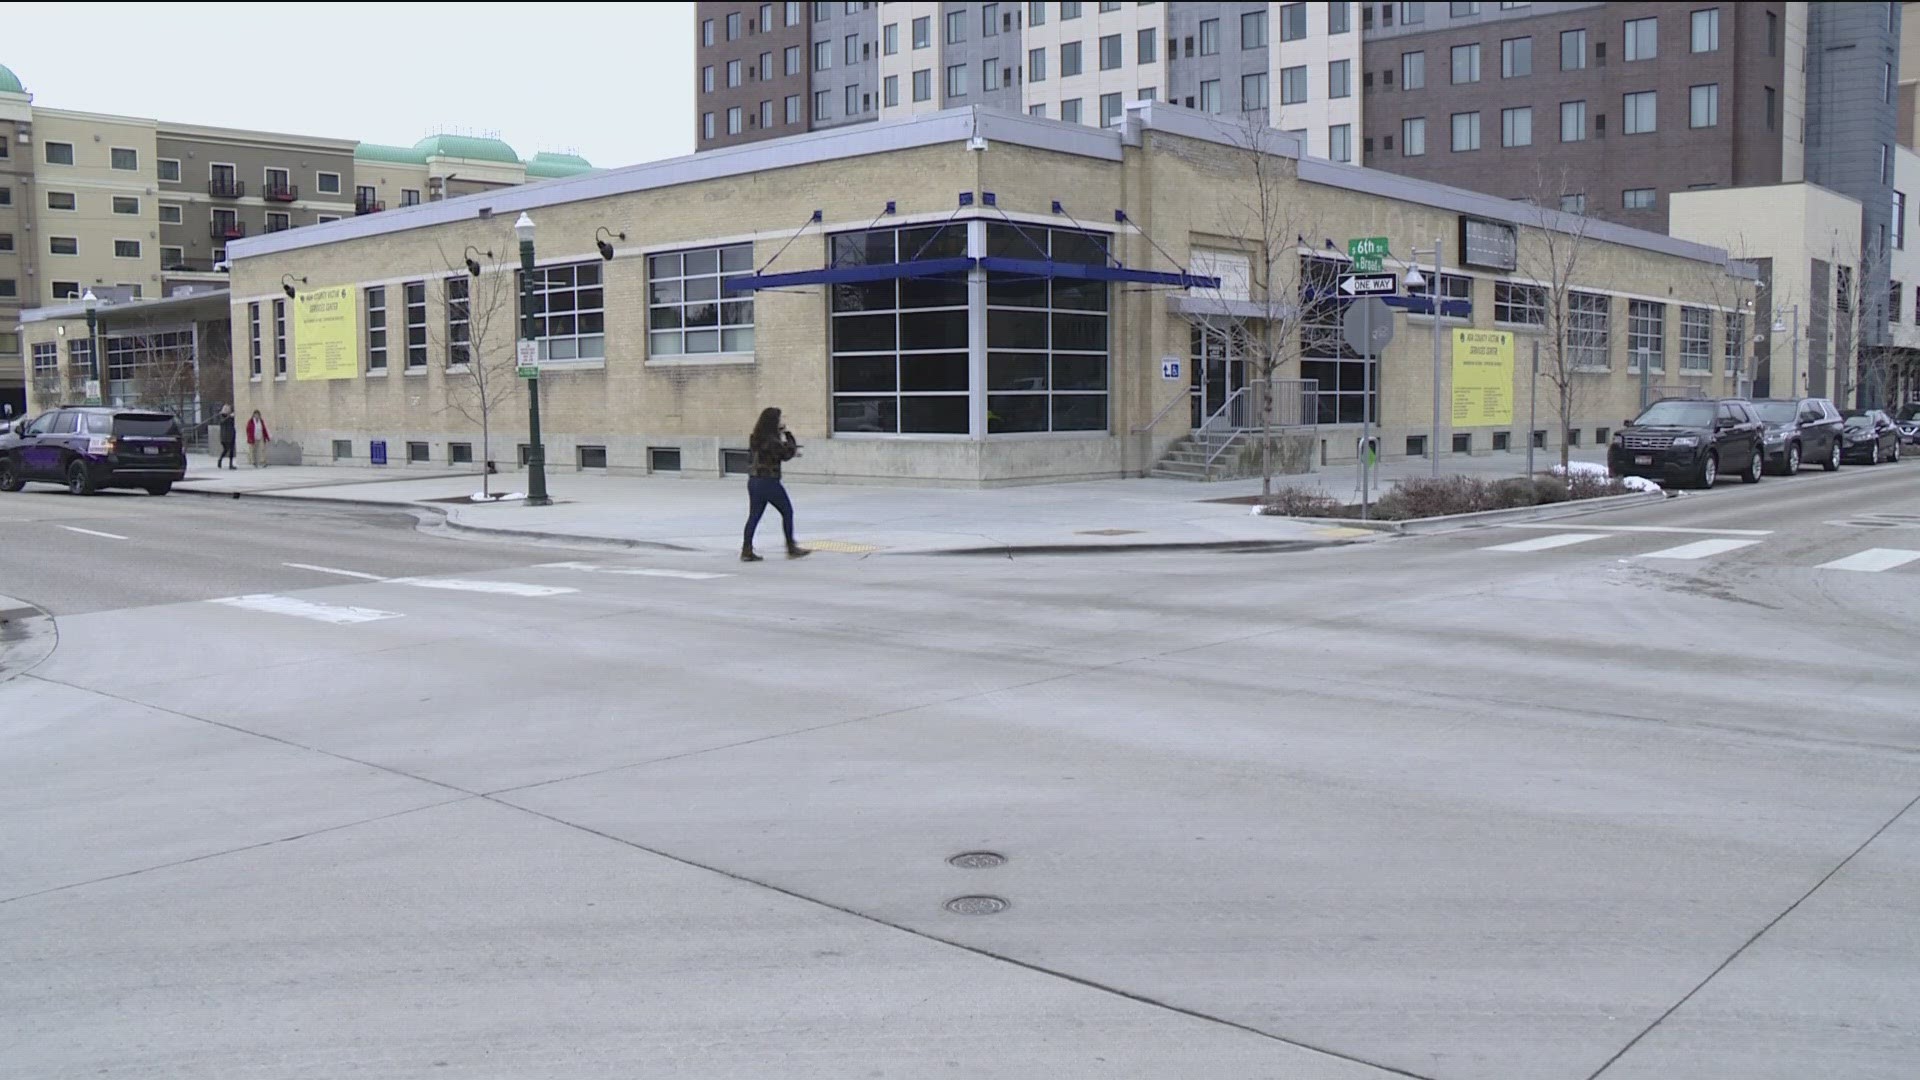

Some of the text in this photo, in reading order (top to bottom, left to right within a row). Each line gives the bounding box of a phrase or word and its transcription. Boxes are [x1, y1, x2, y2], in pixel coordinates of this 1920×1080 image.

[1357, 239, 1374, 254] 6th
[1360, 257, 1378, 271] Broad
[1355, 279, 1390, 290] ONE WAY
